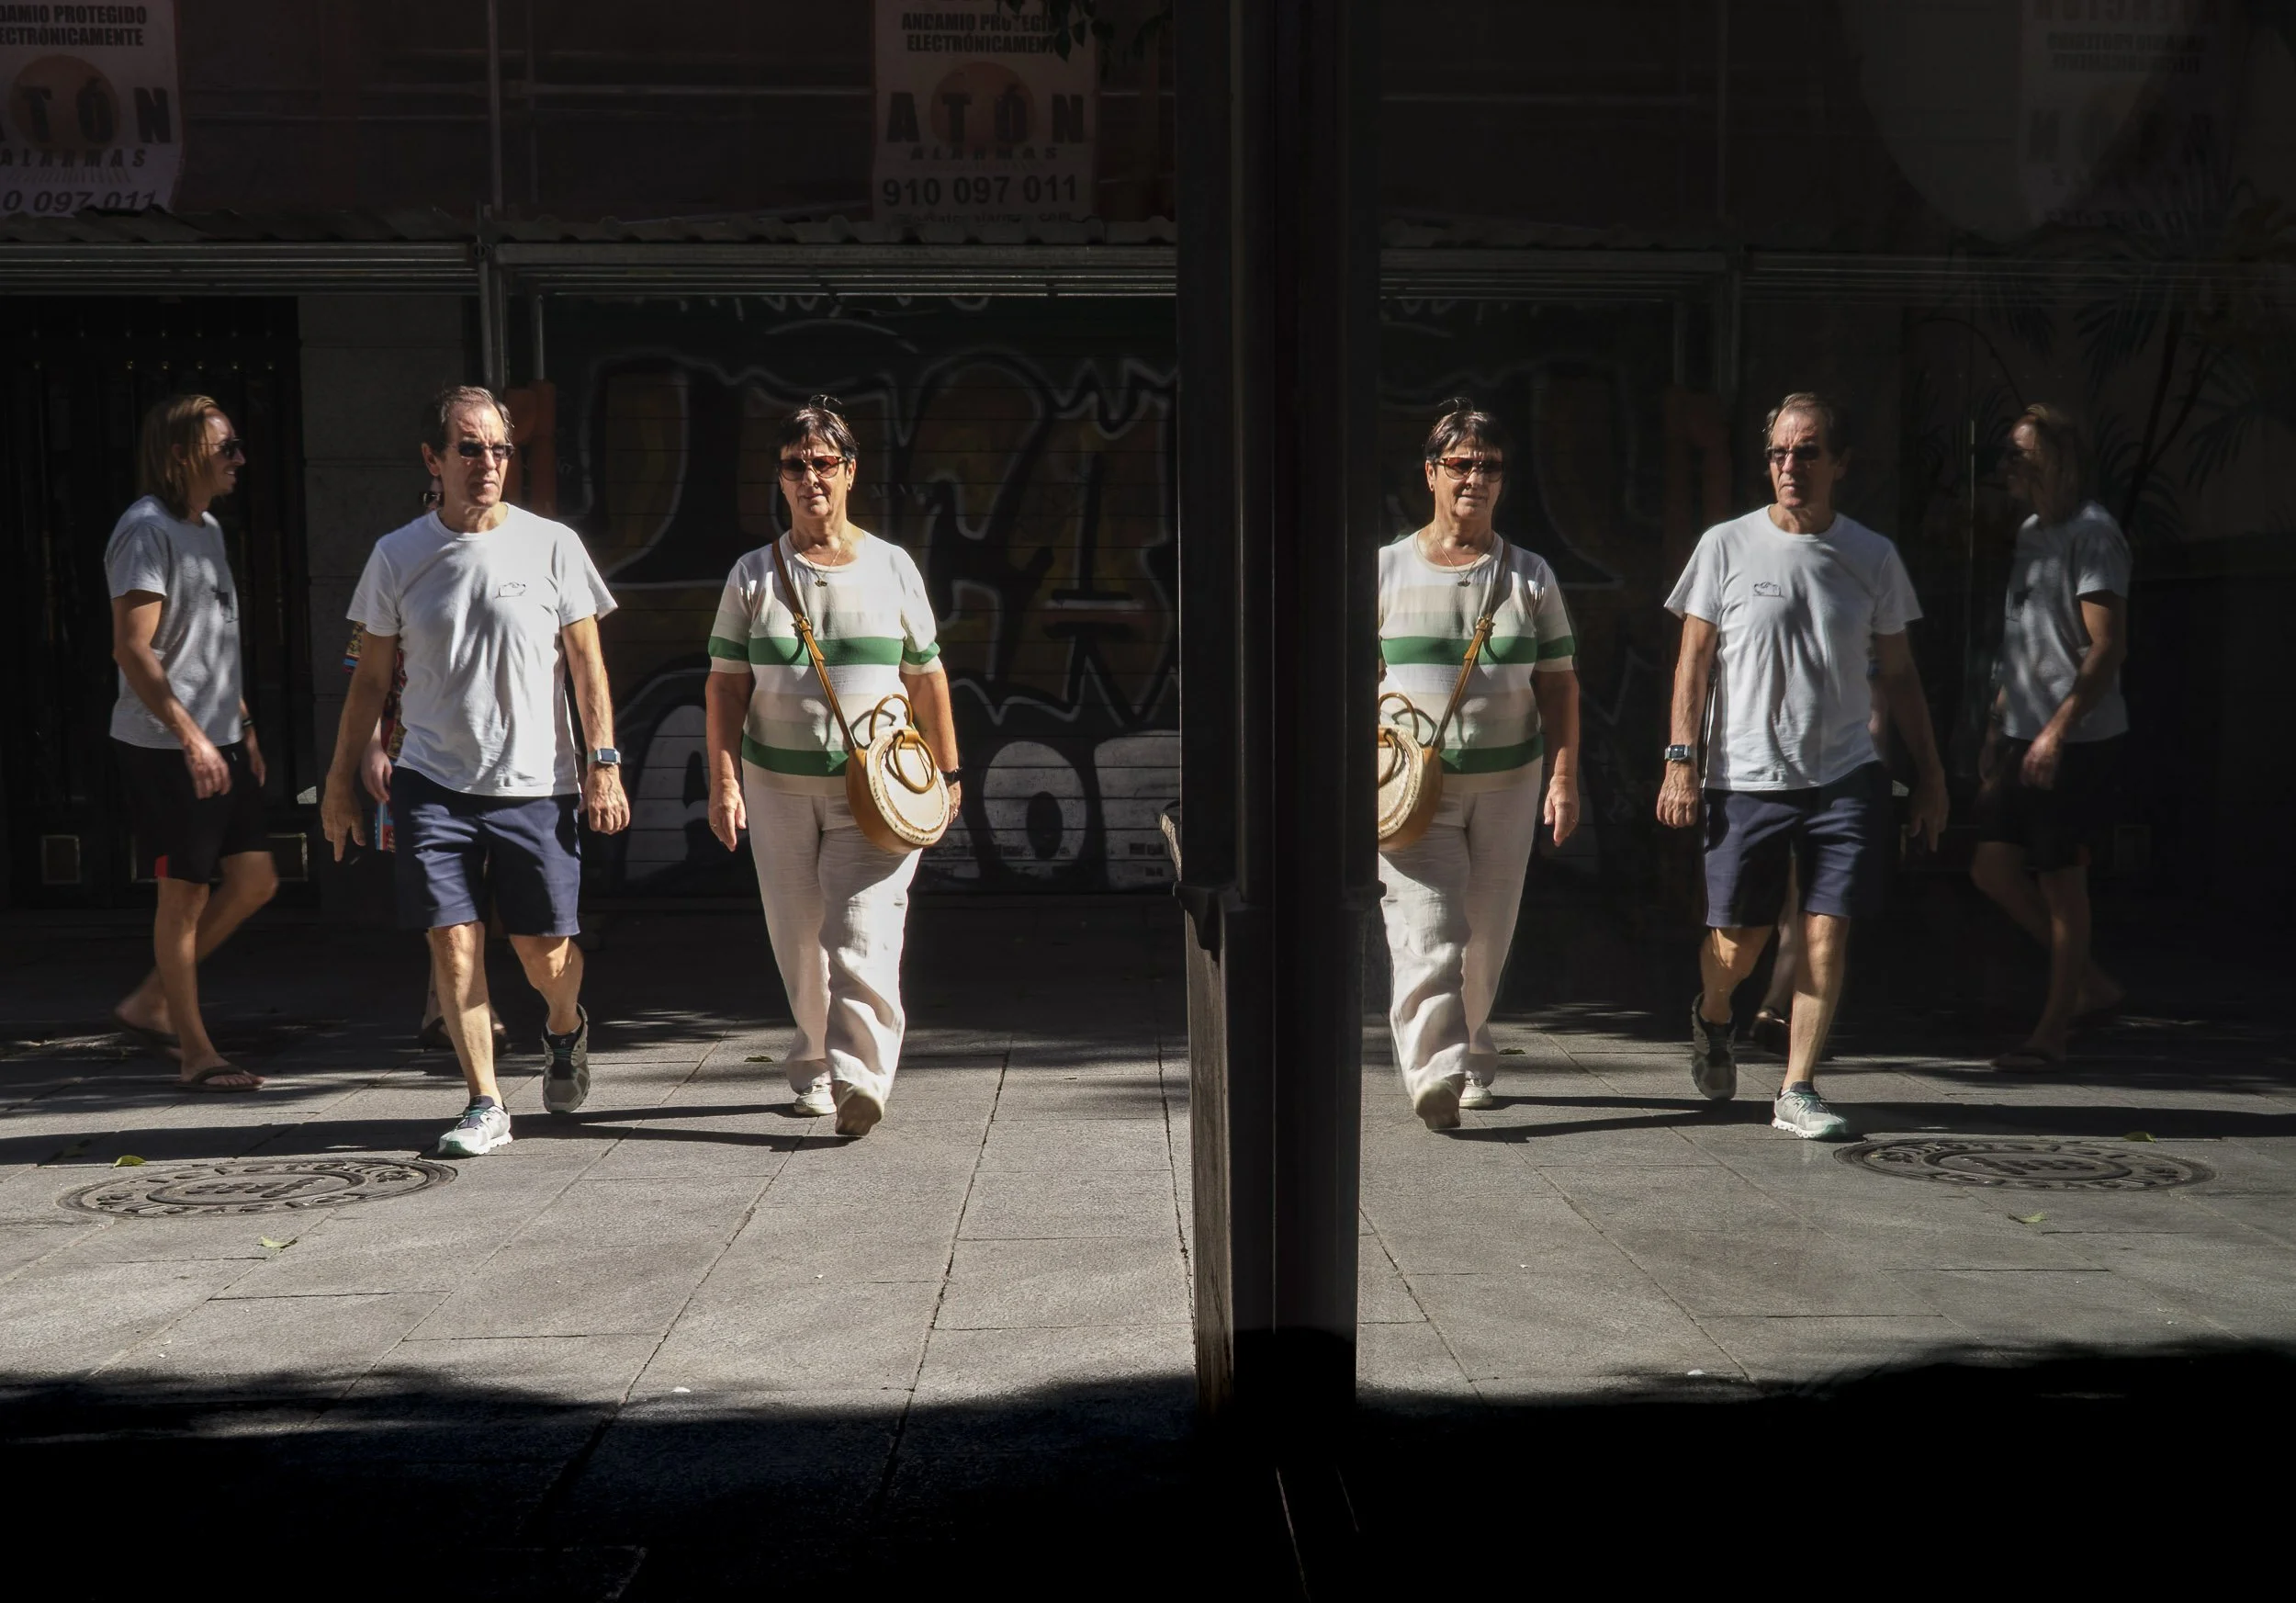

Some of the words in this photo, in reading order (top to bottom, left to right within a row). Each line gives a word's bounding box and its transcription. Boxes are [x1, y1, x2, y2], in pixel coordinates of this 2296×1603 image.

[54, 6, 147, 24] PROTEGIDO
[0, 75, 172, 143] TÓN
[886, 83, 1084, 143] ATÓN
[1, 148, 146, 167] ALARMAS
[911, 147, 1057, 161] ALARMAS
[33, 190, 94, 213] 097
[104, 189, 156, 210] 011
[883, 178, 940, 207] 910
[953, 176, 1010, 205] 097
[1023, 175, 1075, 204] 011
